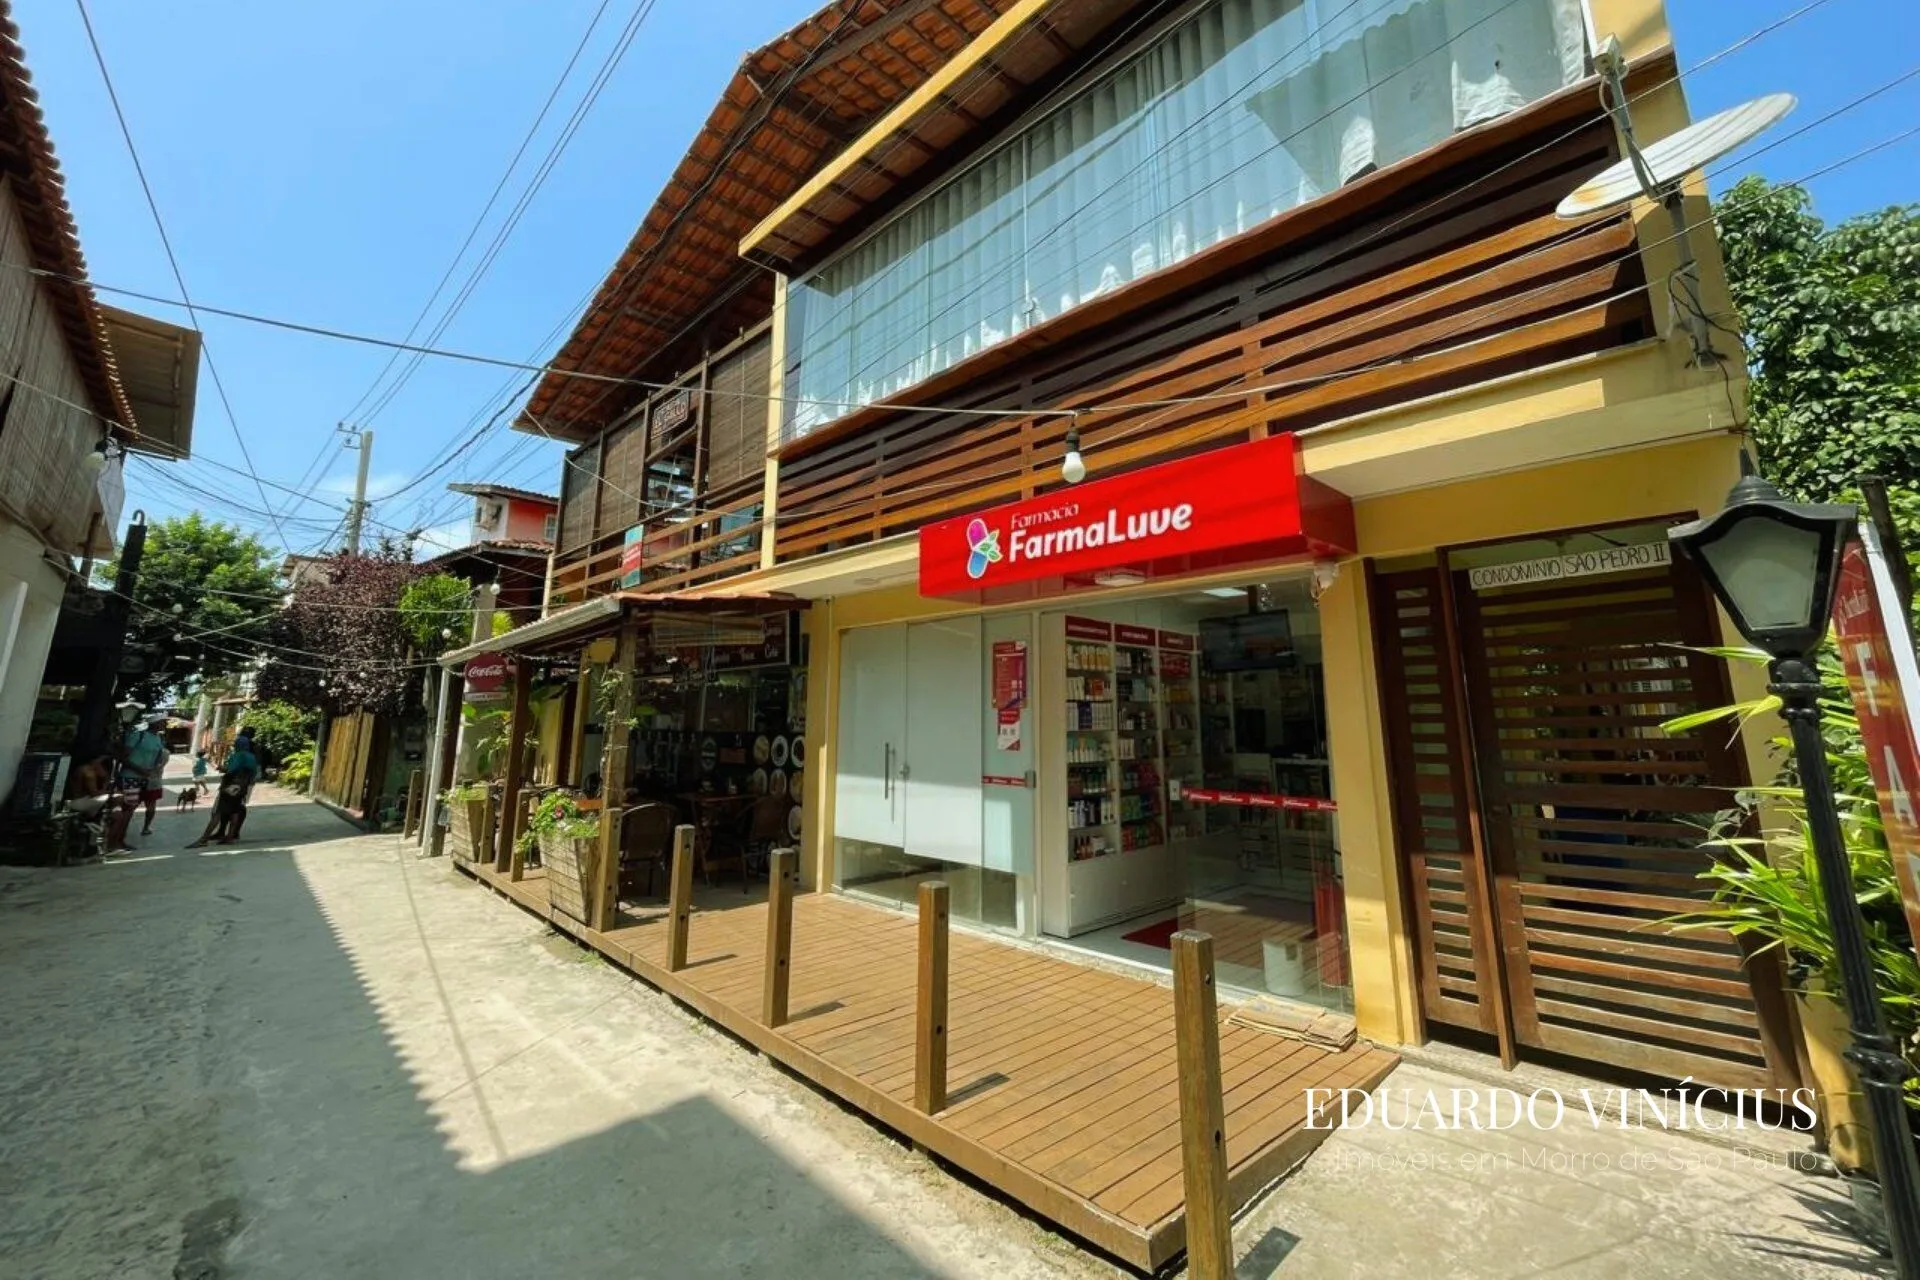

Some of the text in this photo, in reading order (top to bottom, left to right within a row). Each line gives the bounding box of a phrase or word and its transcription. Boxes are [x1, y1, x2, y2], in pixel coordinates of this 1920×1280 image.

[1009, 503, 1193, 563] FarmaLuve
[1599, 546, 1650, 570] PEDRO
[1653, 543, 1669, 562] II
